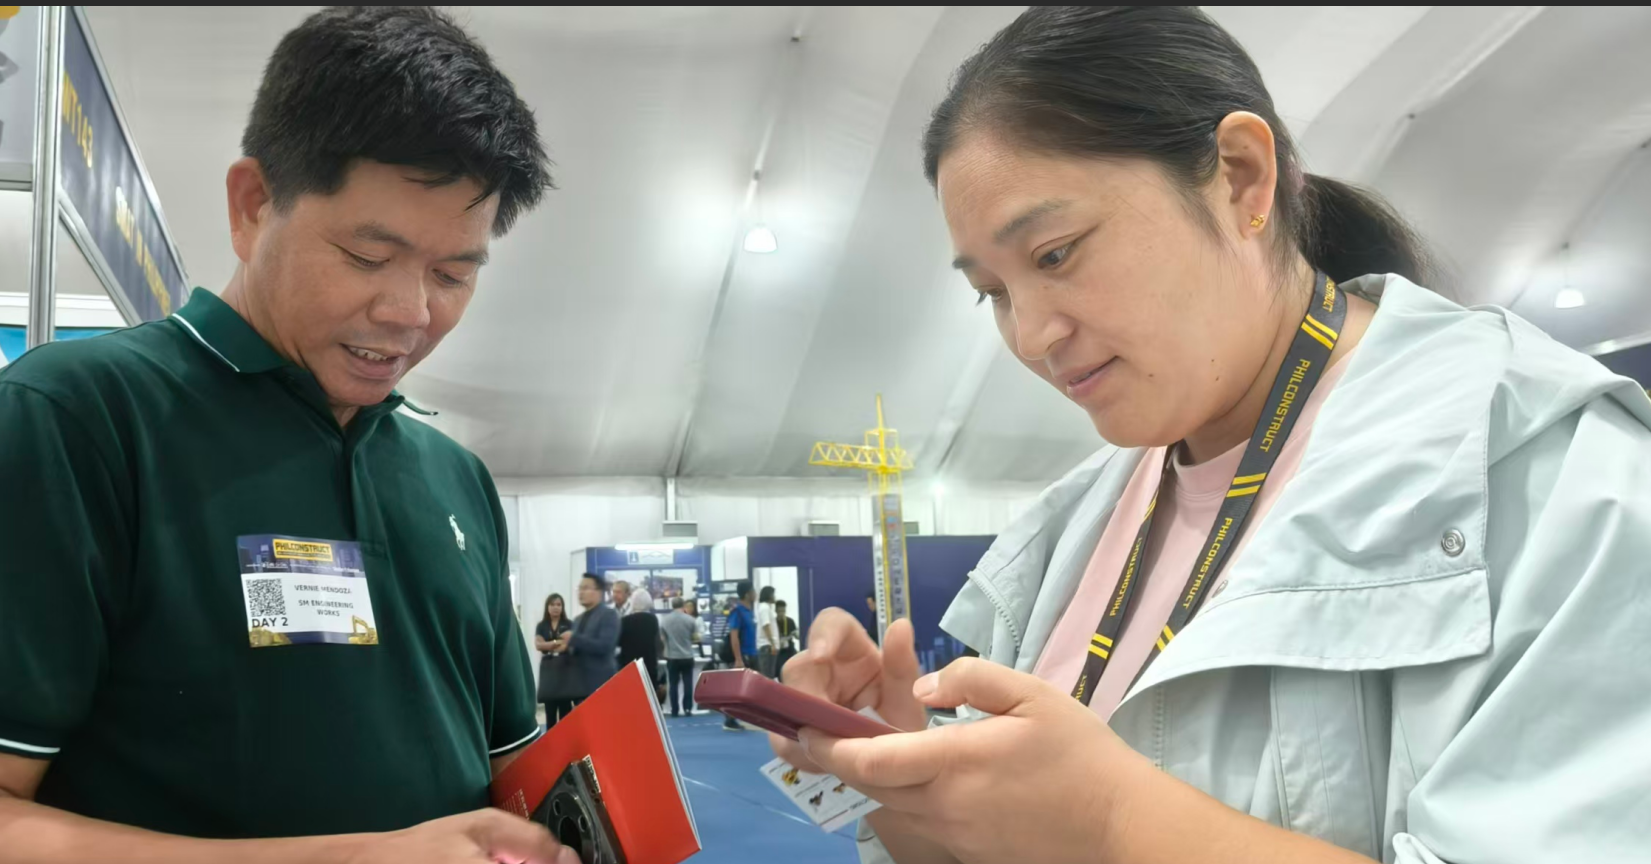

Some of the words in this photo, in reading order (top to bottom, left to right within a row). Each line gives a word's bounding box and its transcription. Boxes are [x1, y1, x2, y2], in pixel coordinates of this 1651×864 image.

[1260, 359, 1311, 452] PHILCONSTRUCT
[275, 542, 331, 554] PHILCONSTRUCT
[1183, 517, 1233, 609] PHILCONSTRUCT
[1109, 537, 1142, 616] PHILCONSTRUCT
[294, 584, 319, 592] VERNIE
[311, 600, 354, 609] ENGINEERING
[317, 609, 340, 617] WORKS
[252, 617, 278, 628] DAY
[281, 616, 289, 627] 2
